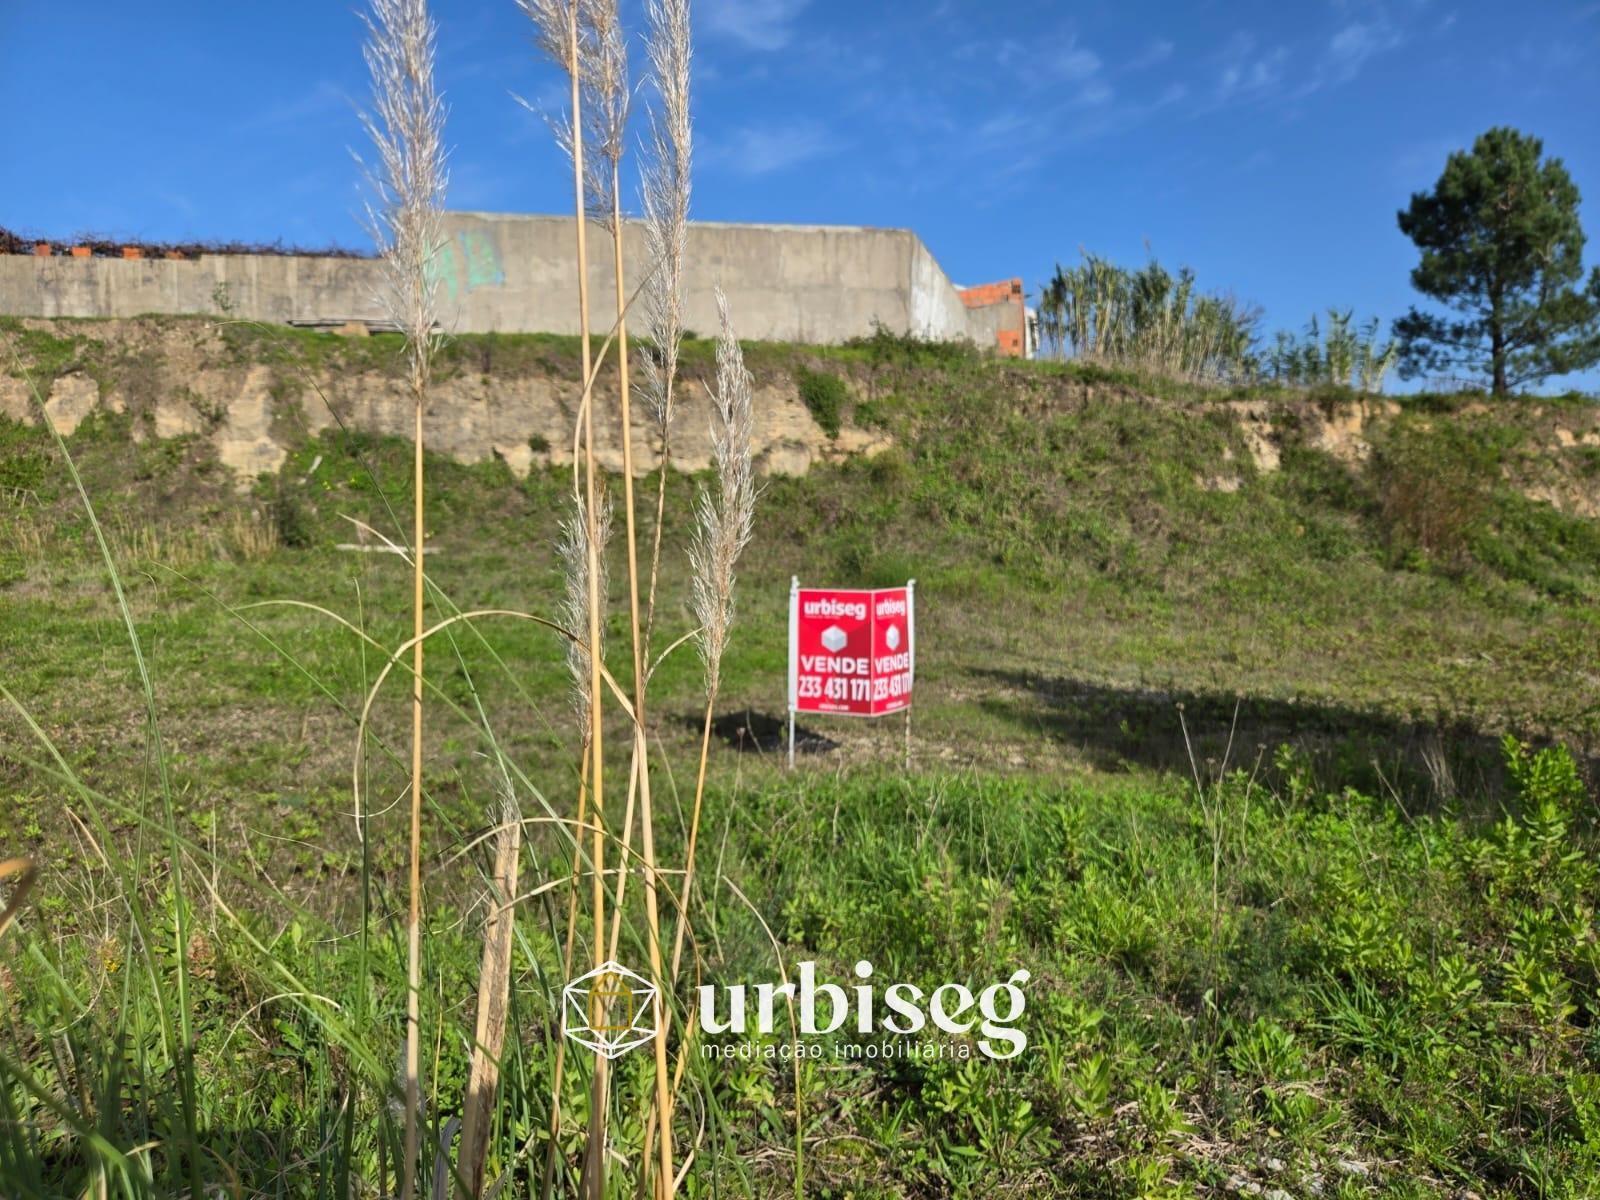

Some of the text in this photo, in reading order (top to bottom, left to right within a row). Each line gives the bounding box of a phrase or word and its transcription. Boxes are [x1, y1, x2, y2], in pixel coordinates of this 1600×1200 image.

[804, 599, 867, 620] urbiseg
[876, 598, 906, 616] urbiseg
[801, 655, 869, 675] VENDE
[875, 653, 909, 673] VENDE
[798, 675, 871, 702] 233 431 171
[874, 678, 888, 700] 233
[888, 674, 901, 698] 431
